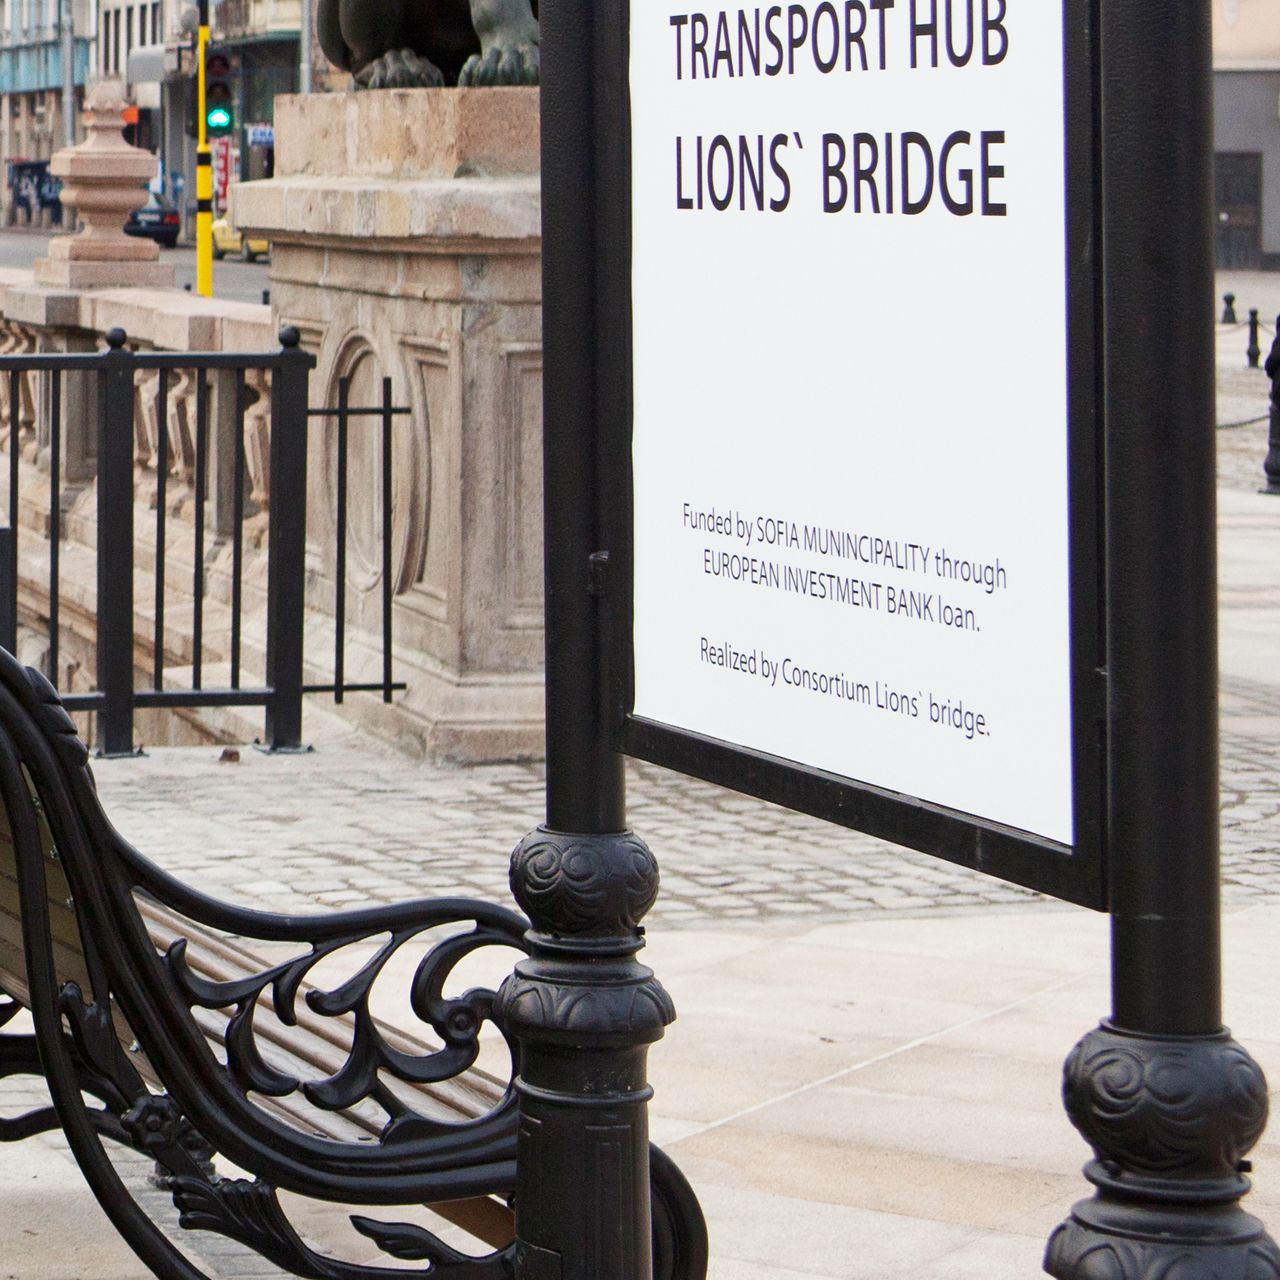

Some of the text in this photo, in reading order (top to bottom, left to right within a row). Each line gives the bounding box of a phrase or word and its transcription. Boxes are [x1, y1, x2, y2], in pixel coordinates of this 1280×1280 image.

[822, 130, 1008, 217] BRIDGE
[683, 502, 1007, 594] Funded by SOFIA MUNINCIPALITY through
[703, 549, 980, 632] EUROPEAN INVESTMENT BANK loan.
[700, 637, 757, 675] Realized
[761, 651, 779, 687] by
[781, 658, 871, 705] Consortium
[929, 693, 991, 740] bridge.
